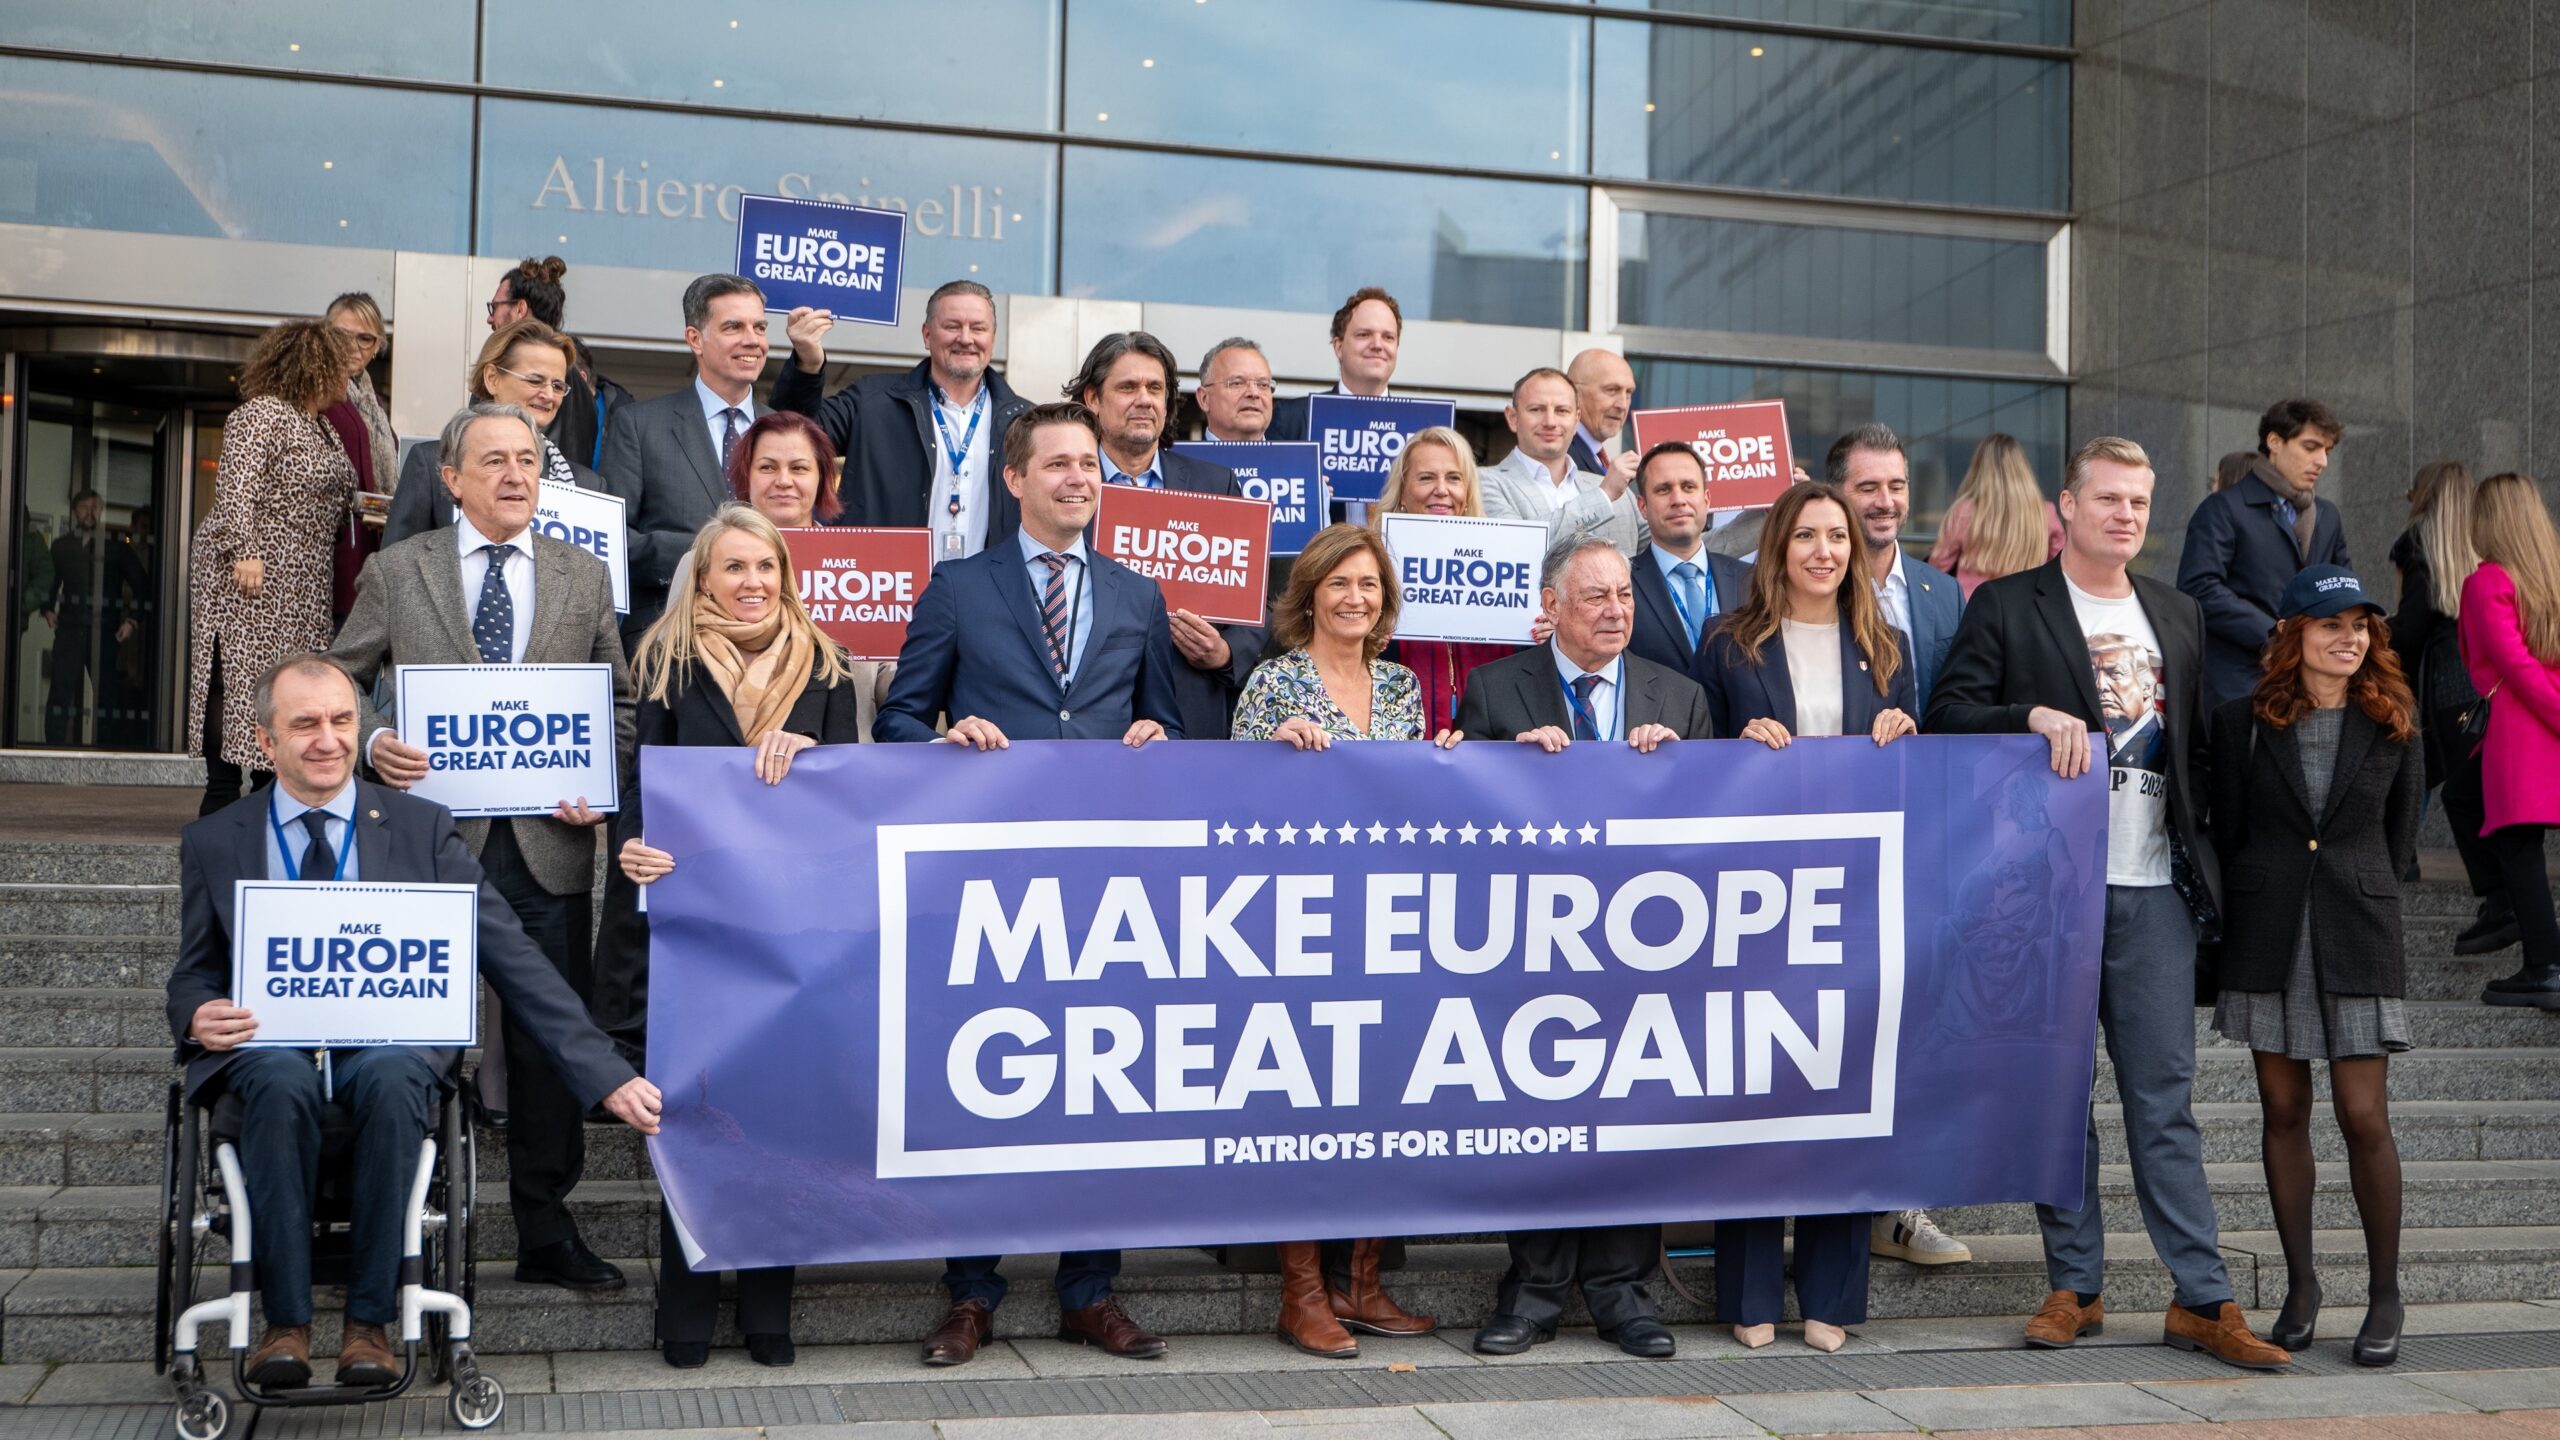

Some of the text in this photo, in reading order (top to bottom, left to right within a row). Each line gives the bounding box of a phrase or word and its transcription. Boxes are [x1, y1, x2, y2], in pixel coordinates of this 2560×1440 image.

[531, 154, 749, 223] Altiero
[808, 228, 838, 240] MAKE
[756, 233, 885, 274] EUROPE
[755, 262, 882, 292] GREAT AGAIN
[1369, 421, 1396, 431] MAKE
[1698, 429, 1726, 440] MAKE
[1324, 428, 1414, 457] EURO
[1654, 435, 1775, 465] ROPE
[1324, 455, 1378, 473] GREAT
[1717, 462, 1776, 482] AGAIN
[1237, 478, 1306, 505] OPE
[1167, 520, 1199, 532] MAKE
[1272, 508, 1305, 523] AIN
[531, 516, 608, 558] OPE
[1113, 525, 1250, 568] EUROPE
[822, 558, 857, 568] MAKE
[1454, 548, 1483, 558] MAKE
[1178, 565, 1246, 587] AGAIN
[1403, 557, 1530, 590] EUROPE
[2315, 577, 2338, 588] MAKE
[799, 570, 913, 601] UROPE
[2319, 582, 2341, 592] GREAT
[1403, 587, 1528, 608] GREAT AGAIN
[840, 604, 912, 622] AGAIN
[491, 700, 529, 711] MAKE
[427, 713, 591, 748] EUROPE
[429, 750, 591, 771] GREAT AGAIN
[339, 923, 381, 935] MAKE
[948, 866, 1845, 985] MAKE EUROPE
[266, 936, 450, 973] EUROPE
[266, 976, 448, 998] GREAT AGAIN
[947, 990, 1845, 1119] GREAT AGAIN
[1214, 1126, 1588, 1164] PATRIOTS FOR EUROPE
